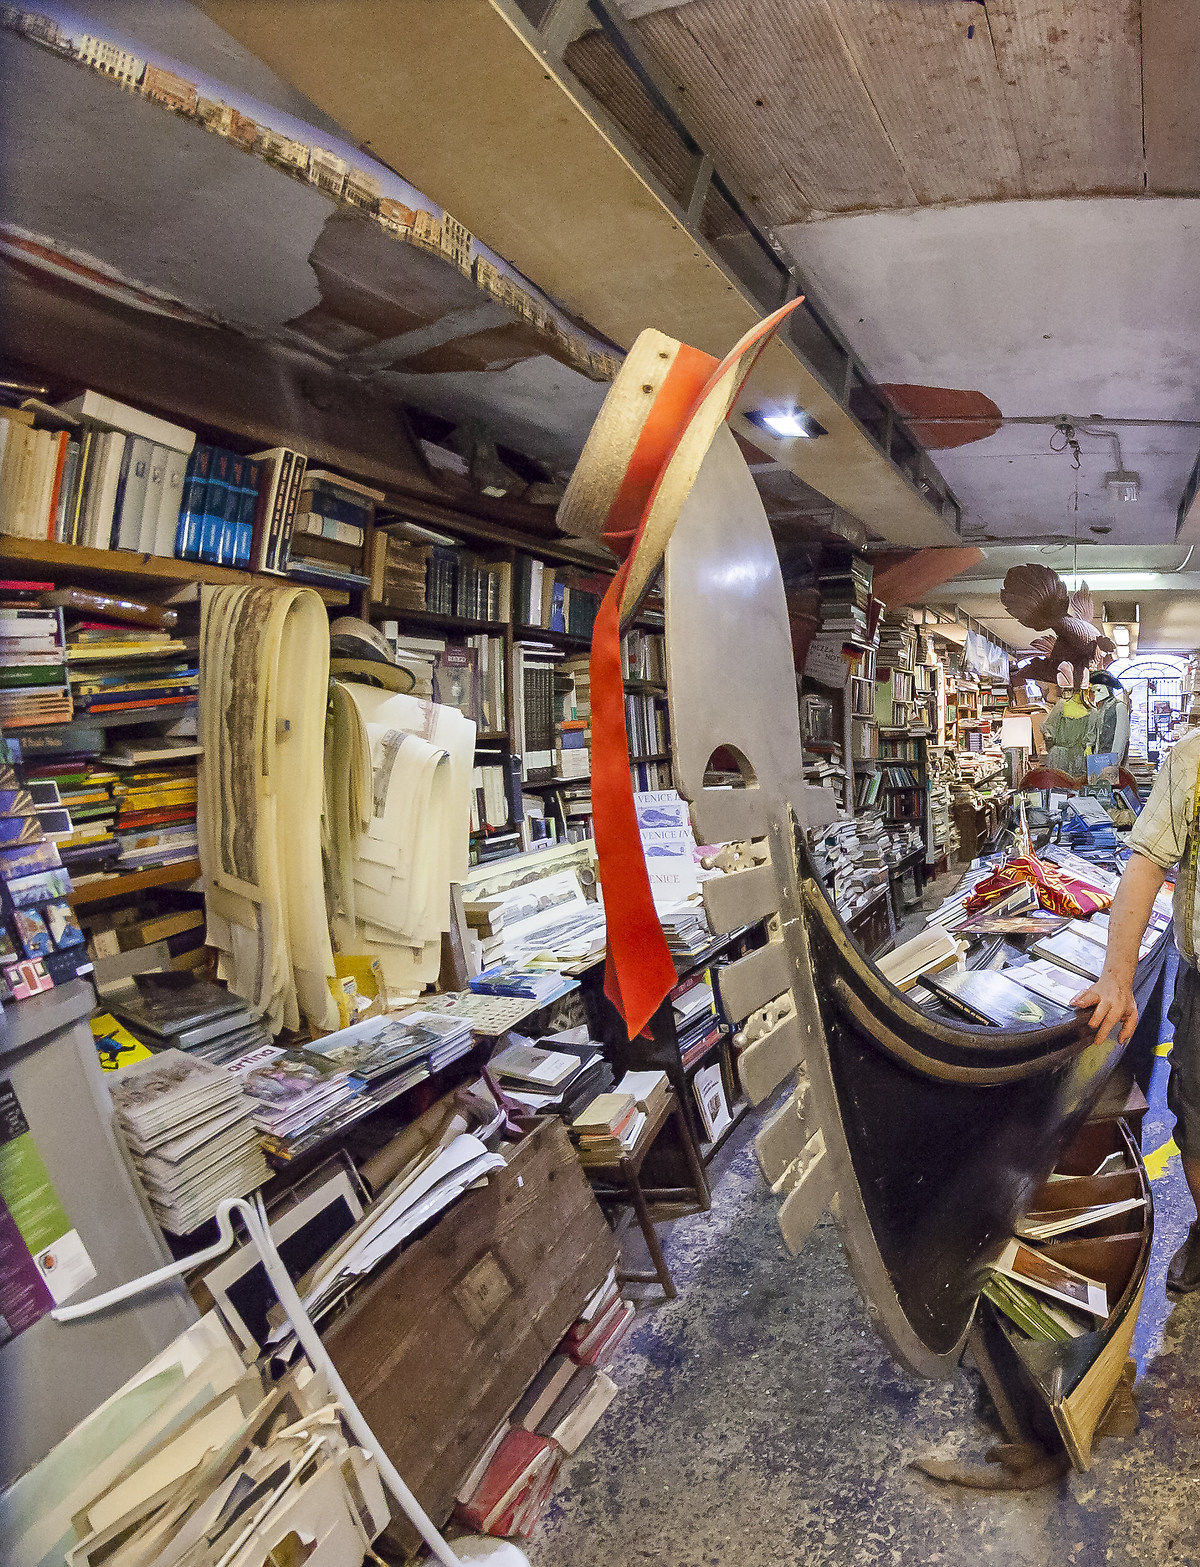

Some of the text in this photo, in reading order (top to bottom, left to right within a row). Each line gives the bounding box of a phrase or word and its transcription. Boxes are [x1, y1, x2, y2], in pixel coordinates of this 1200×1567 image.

[637, 793, 673, 803] VENICE
[640, 829, 678, 841] VENICE
[649, 872, 680, 884] ENICE
